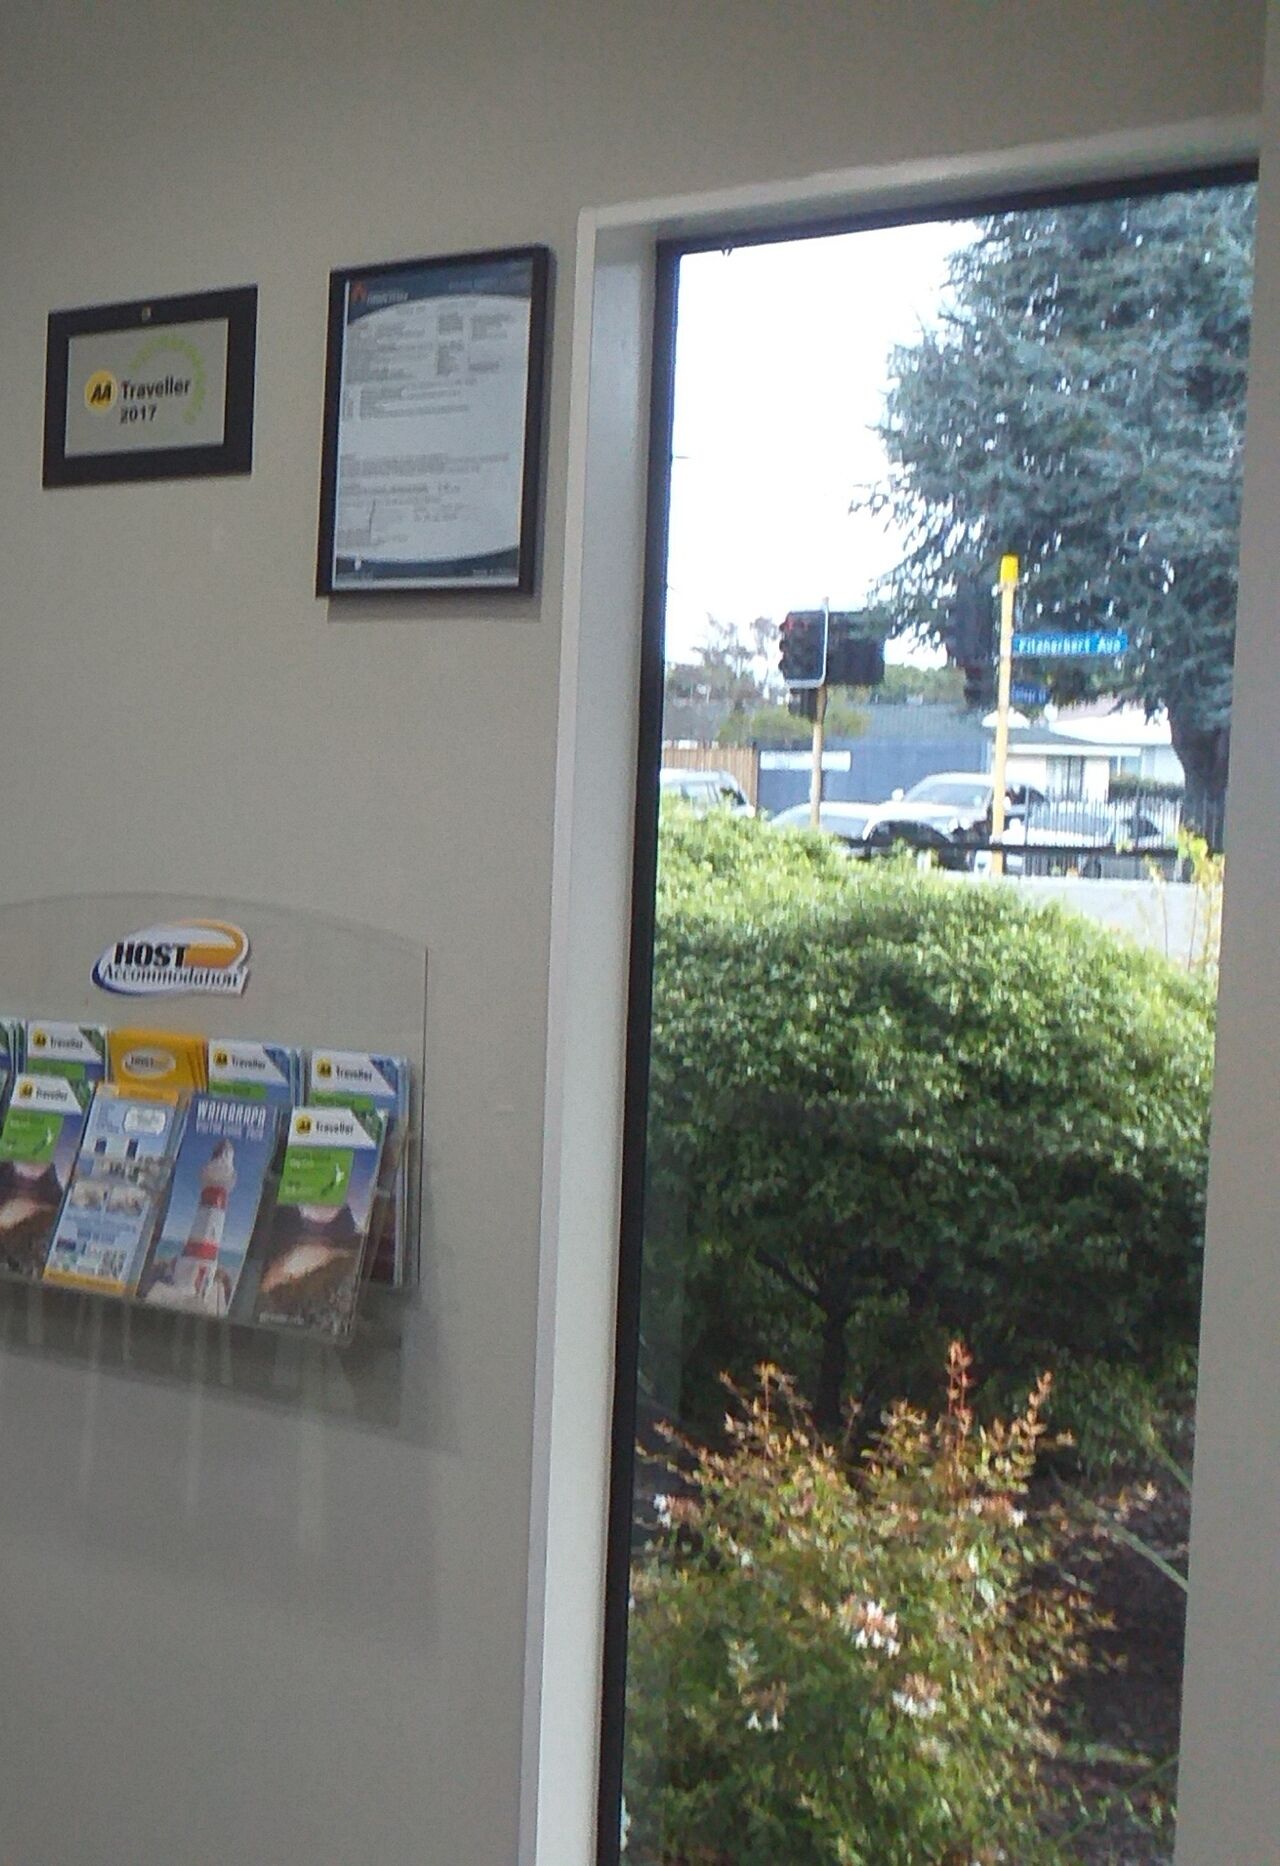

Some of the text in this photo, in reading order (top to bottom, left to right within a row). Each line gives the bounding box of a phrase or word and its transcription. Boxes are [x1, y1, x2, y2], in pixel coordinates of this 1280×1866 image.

[91, 375, 191, 404] AA Traveller
[119, 404, 158, 426] 2017
[1096, 637, 1121, 655] Ave
[114, 941, 187, 969] HOST
[101, 962, 238, 988] Accommodation
[197, 1100, 267, 1129] WAIRARAPA
